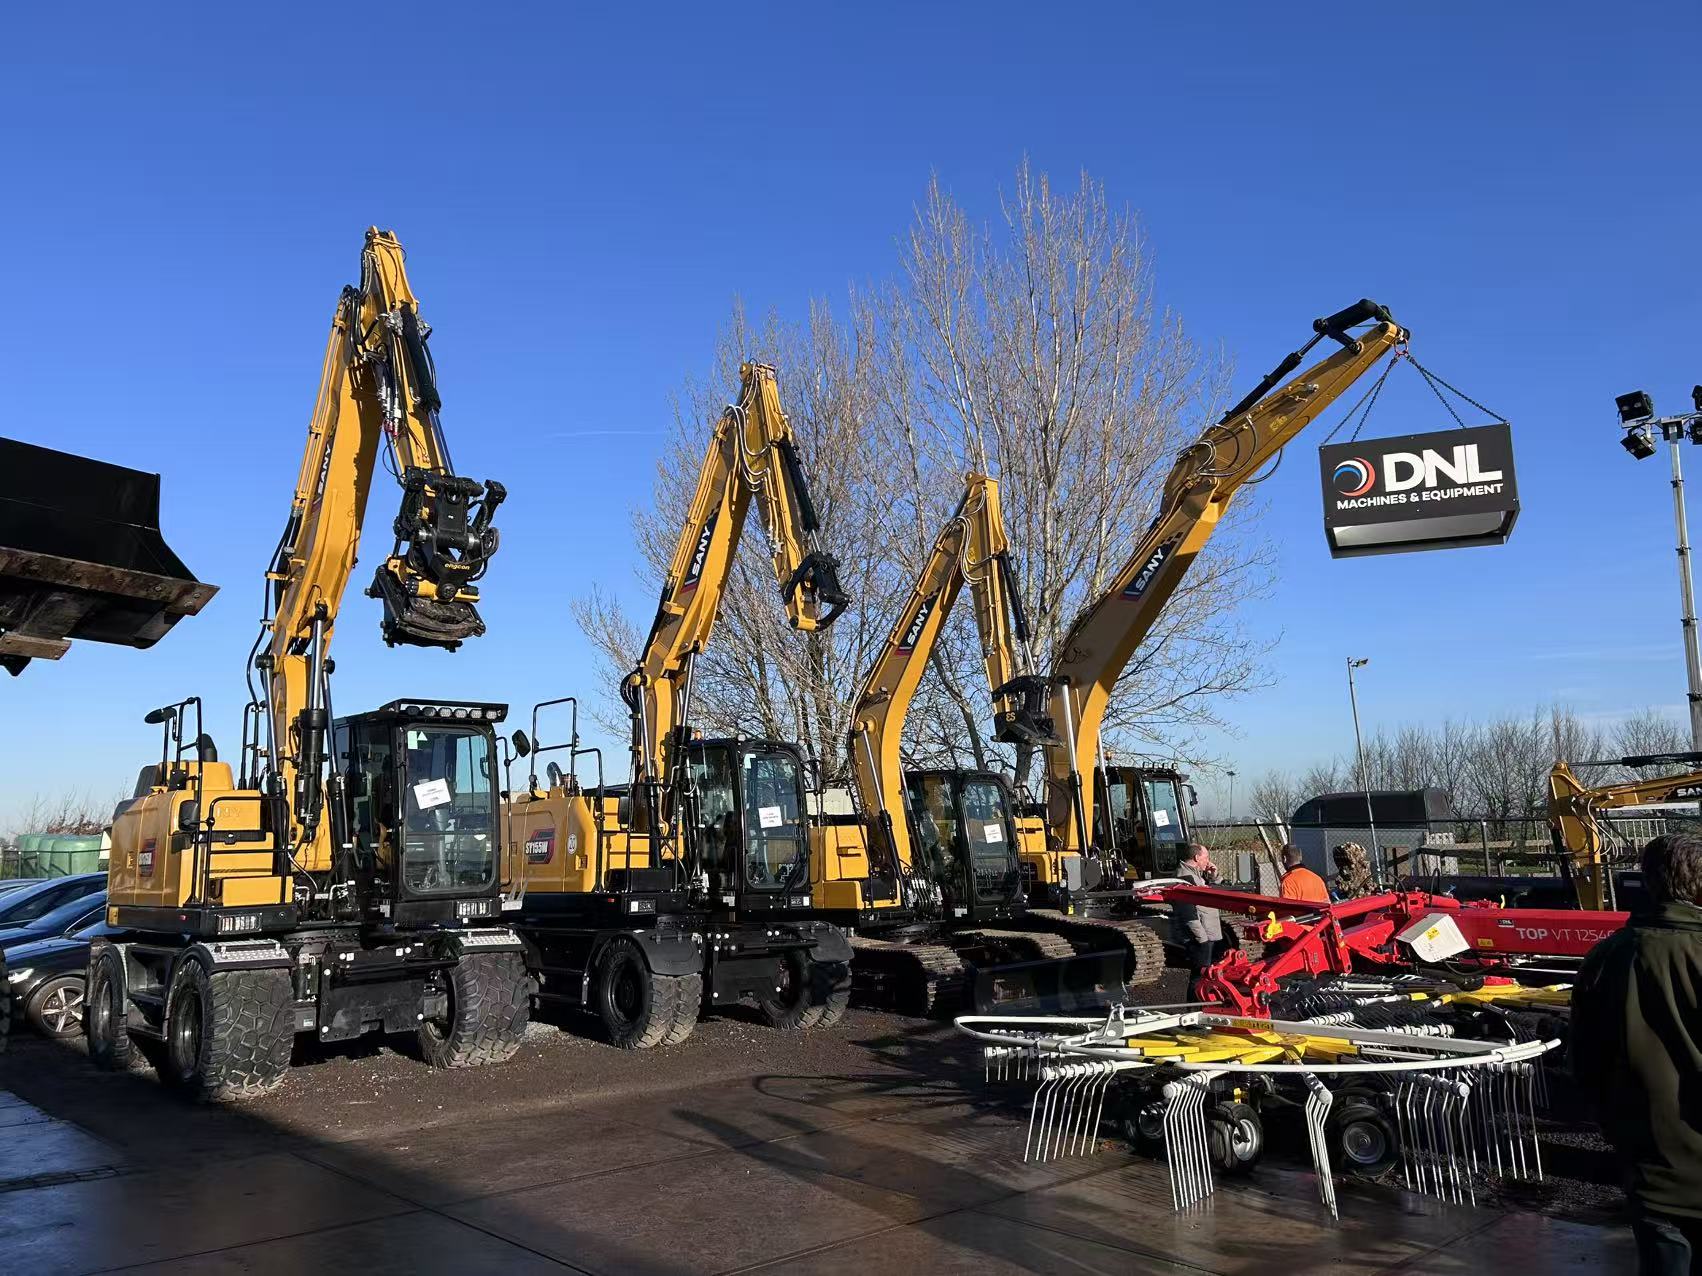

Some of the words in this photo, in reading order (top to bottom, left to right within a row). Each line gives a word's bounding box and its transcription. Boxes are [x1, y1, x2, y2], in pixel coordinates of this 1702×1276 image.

[1382, 443, 1503, 492] DNL
[1336, 493, 1407, 510] MACHINES
[1409, 492, 1420, 503] &
[1421, 483, 1504, 502] EQUIPMENT
[692, 525, 711, 577] SANY
[1135, 547, 1164, 591] SANY
[907, 603, 928, 646] SANY
[525, 841, 549, 854] SY155W
[1516, 927, 1548, 940] TOP
[1551, 928, 1571, 941] VT
